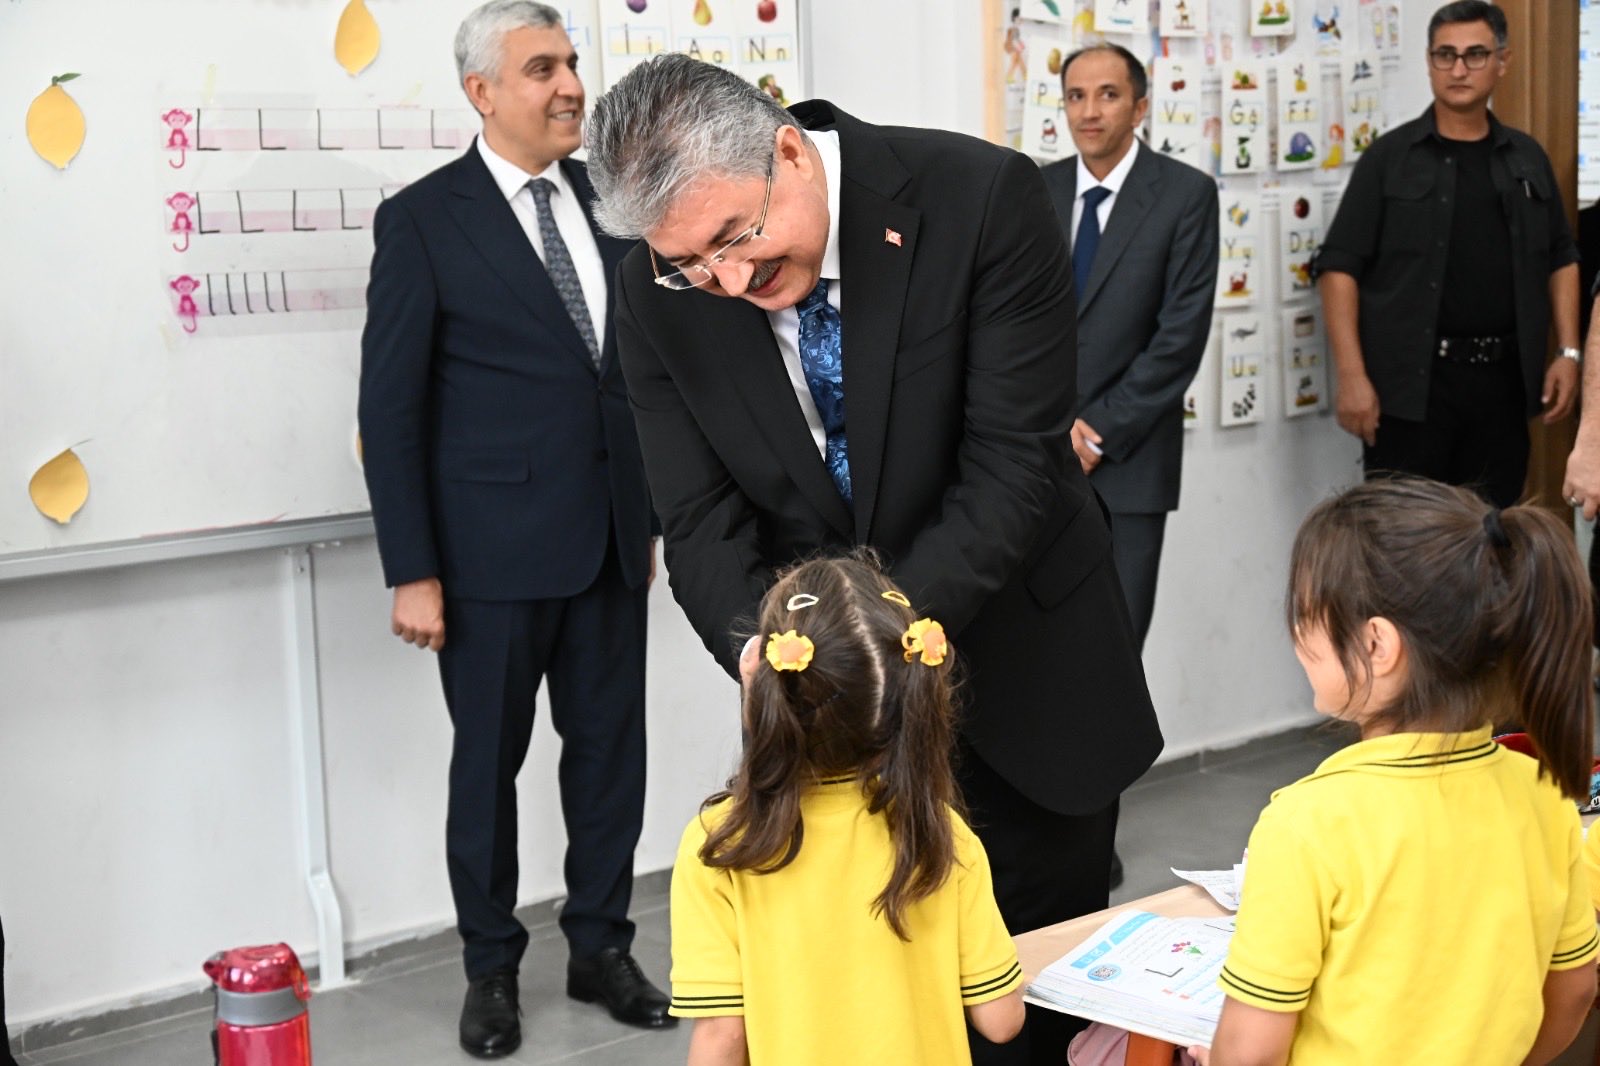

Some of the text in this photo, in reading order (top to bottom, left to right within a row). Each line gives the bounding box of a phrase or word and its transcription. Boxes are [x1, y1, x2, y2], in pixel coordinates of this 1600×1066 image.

[688, 38, 724, 63] A a
[749, 37, 787, 62] N n
[1037, 82, 1047, 106] P
[1164, 101, 1177, 123] V
